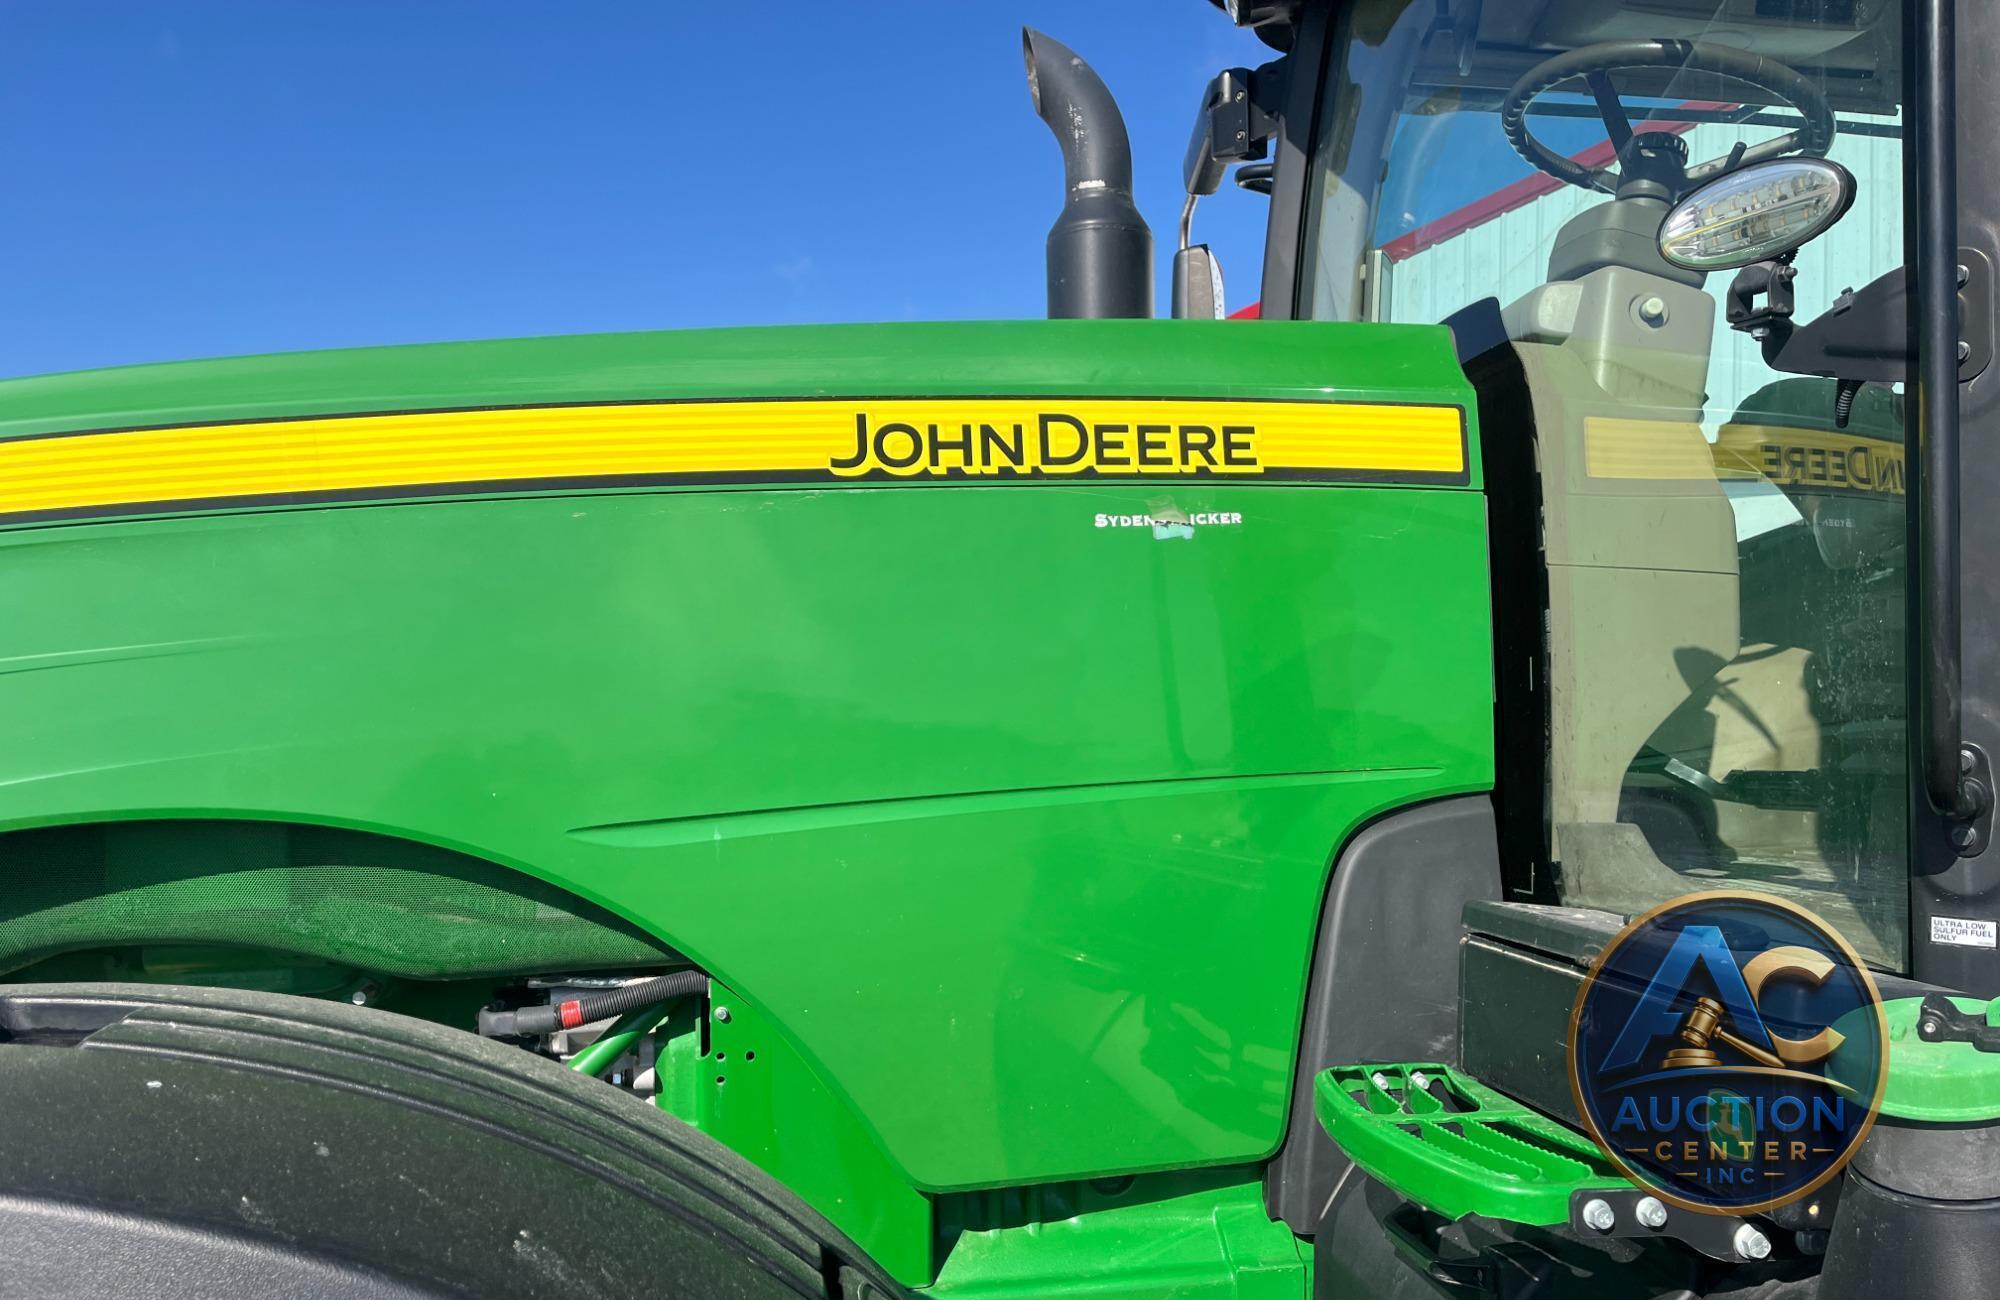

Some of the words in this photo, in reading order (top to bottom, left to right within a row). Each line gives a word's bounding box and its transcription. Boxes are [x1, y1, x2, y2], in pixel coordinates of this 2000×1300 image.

[830, 413, 1024, 468] JOHN
[1039, 413, 1258, 466] DEERE
[1095, 512, 1242, 527] SYDENICKER
[1933, 919, 1963, 928] ULTRA
[1965, 922, 1986, 930] LOW
[1933, 926, 1968, 936] SULFUR
[1970, 929, 1993, 938] FUEL
[1933, 933, 1957, 941] ONLY
